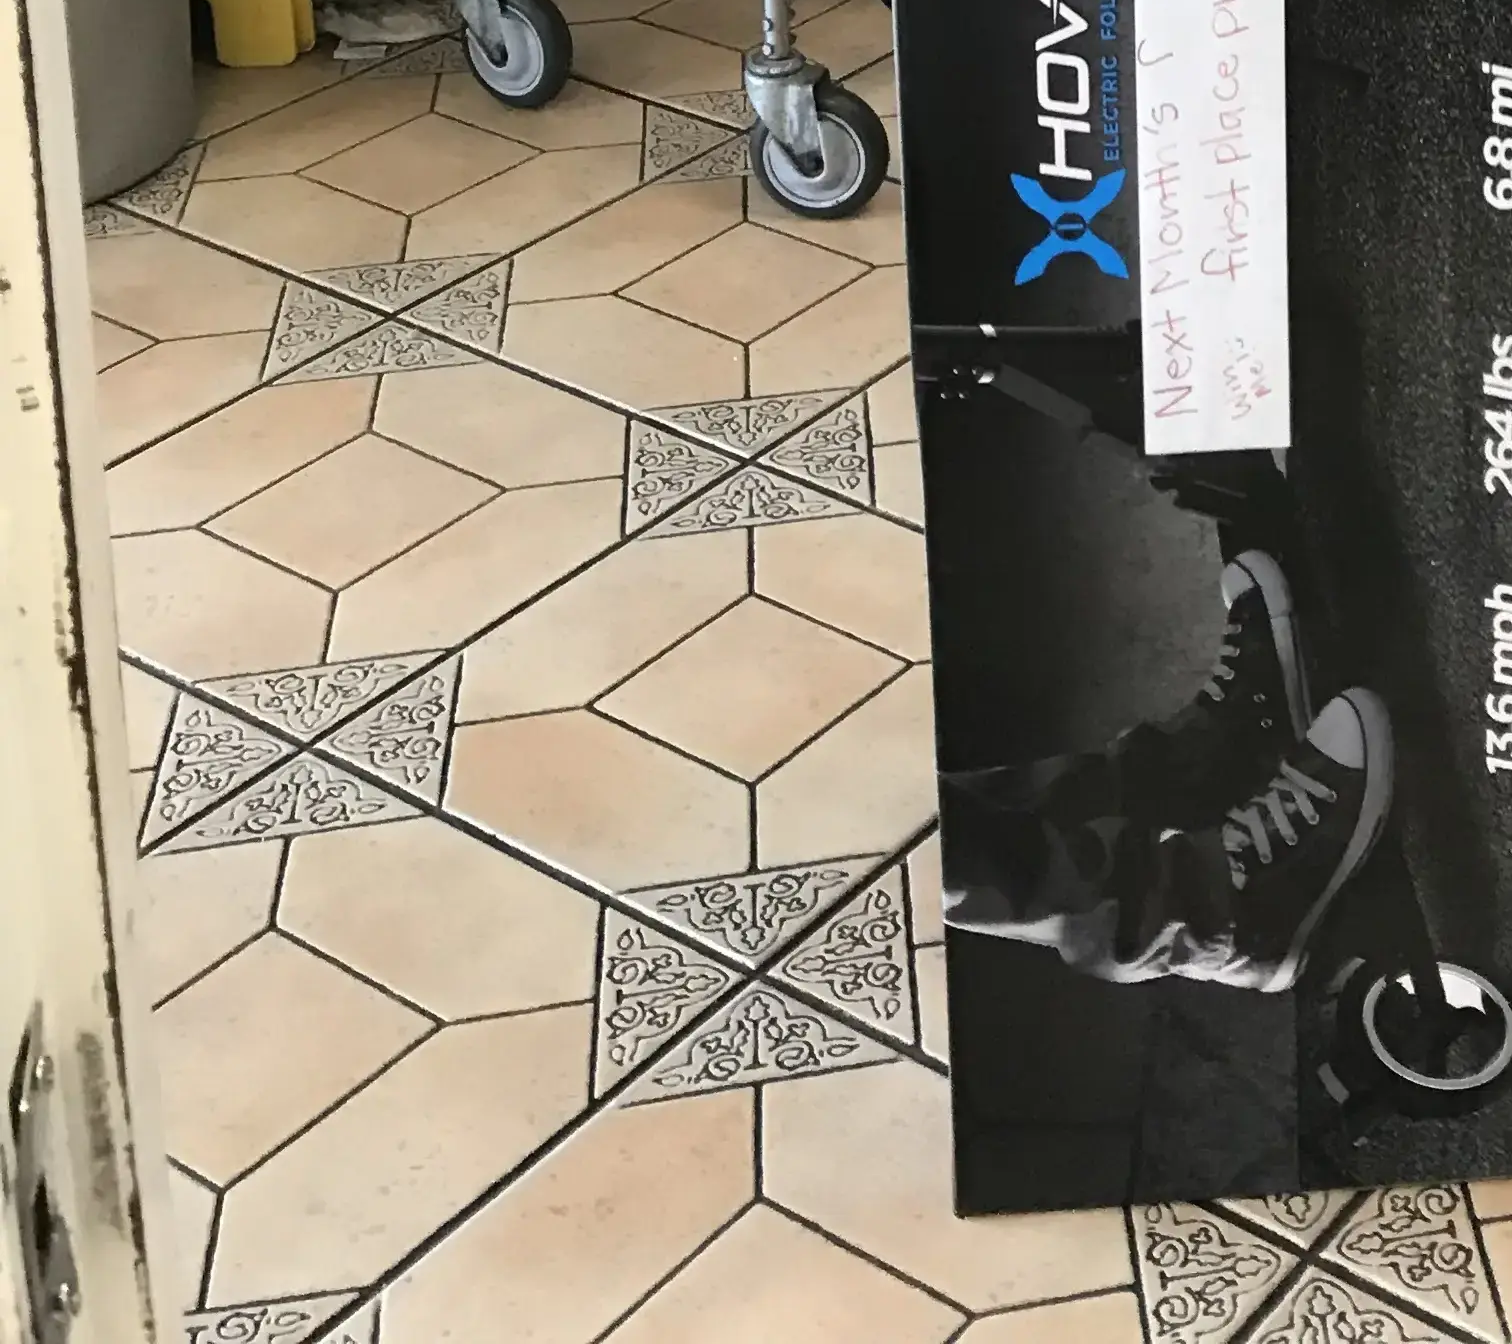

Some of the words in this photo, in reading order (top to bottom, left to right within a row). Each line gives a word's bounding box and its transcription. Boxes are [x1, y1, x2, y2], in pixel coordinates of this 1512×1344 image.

[1100, 55, 1121, 162] ELECTRIC
[1200, 53, 1252, 165] place
[1142, 102, 1190, 295] Month's
[1200, 178, 1251, 282] first
[1150, 309, 1199, 418] Next
